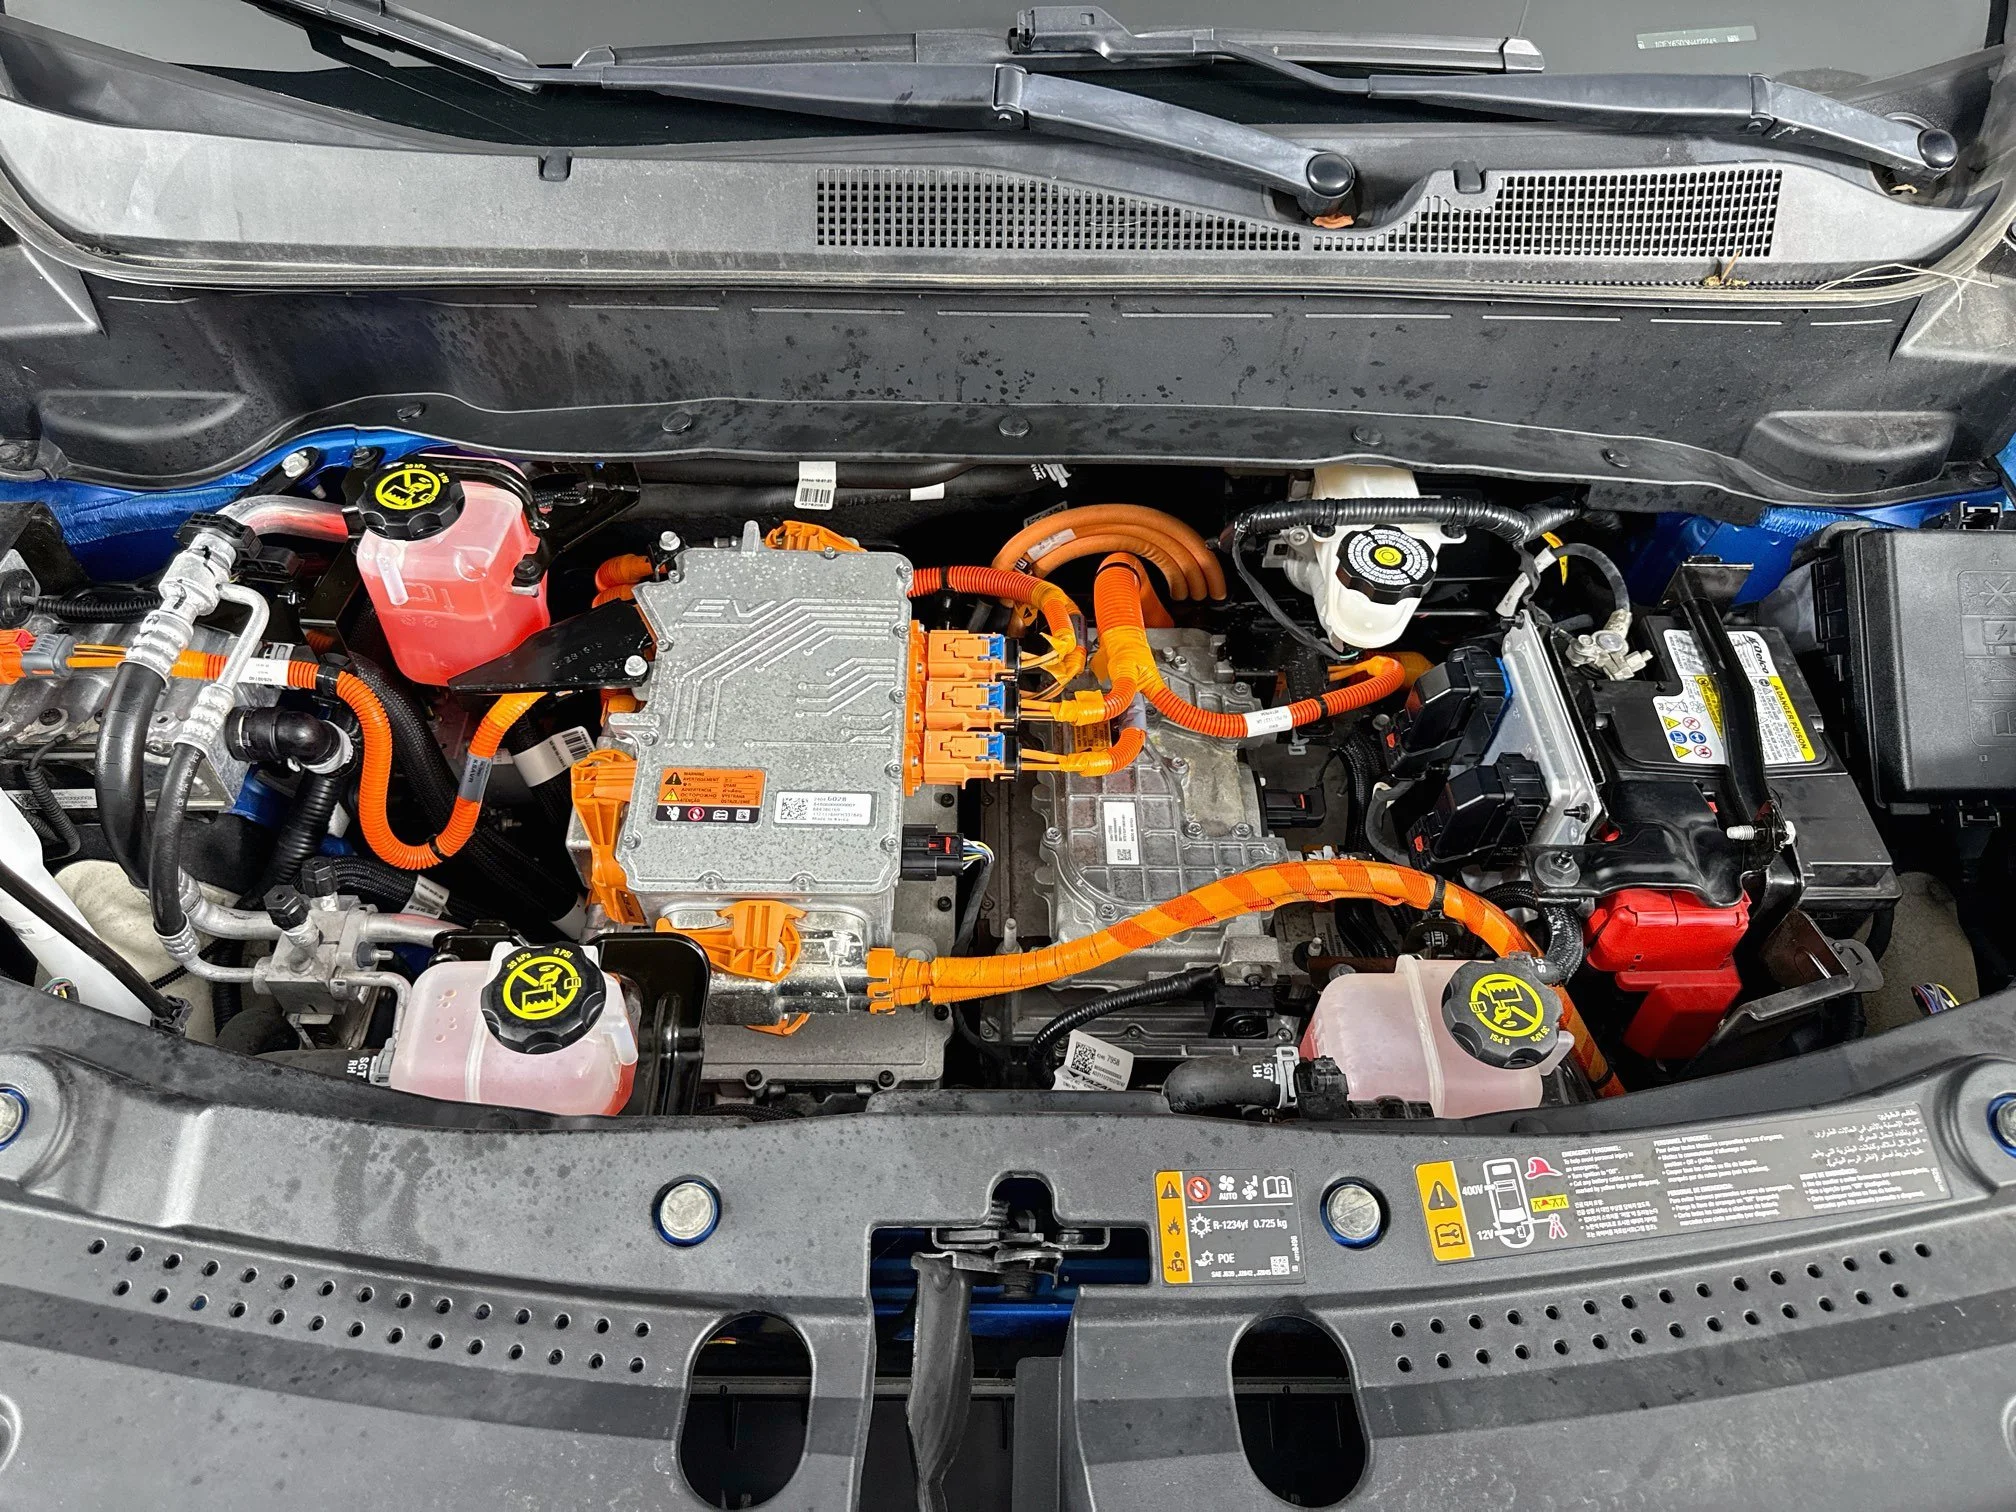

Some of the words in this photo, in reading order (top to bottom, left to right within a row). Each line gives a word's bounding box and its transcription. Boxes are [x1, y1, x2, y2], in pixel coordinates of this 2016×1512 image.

[1746, 634, 1769, 674] ACDelco
[560, 949, 573, 959] PSI
[506, 960, 518, 970] 35
[516, 952, 532, 963] kPa
[1535, 958, 1546, 973] SG
[1540, 1026, 1550, 1035] 35
[1490, 1033, 1504, 1044] PSI
[1530, 1032, 1544, 1043] kPa
[347, 1060, 358, 1074] RH
[357, 1057, 369, 1078] SGT
[1253, 1065, 1262, 1077] LH
[1263, 1063, 1273, 1082] SGT
[1082, 1076, 1113, 1090] YAZA
[1562, 1148, 1590, 1157] EMERGENCY
[1594, 1154, 1614, 1162] personal
[1462, 1184, 1484, 1196] 400V
[1213, 1220, 1249, 1230] R-1234yf
[1254, 1219, 1276, 1228] 0.725
[1277, 1219, 1288, 1229] kg
[1477, 1229, 1494, 1240] 12V
[1218, 1253, 1235, 1263] POE
